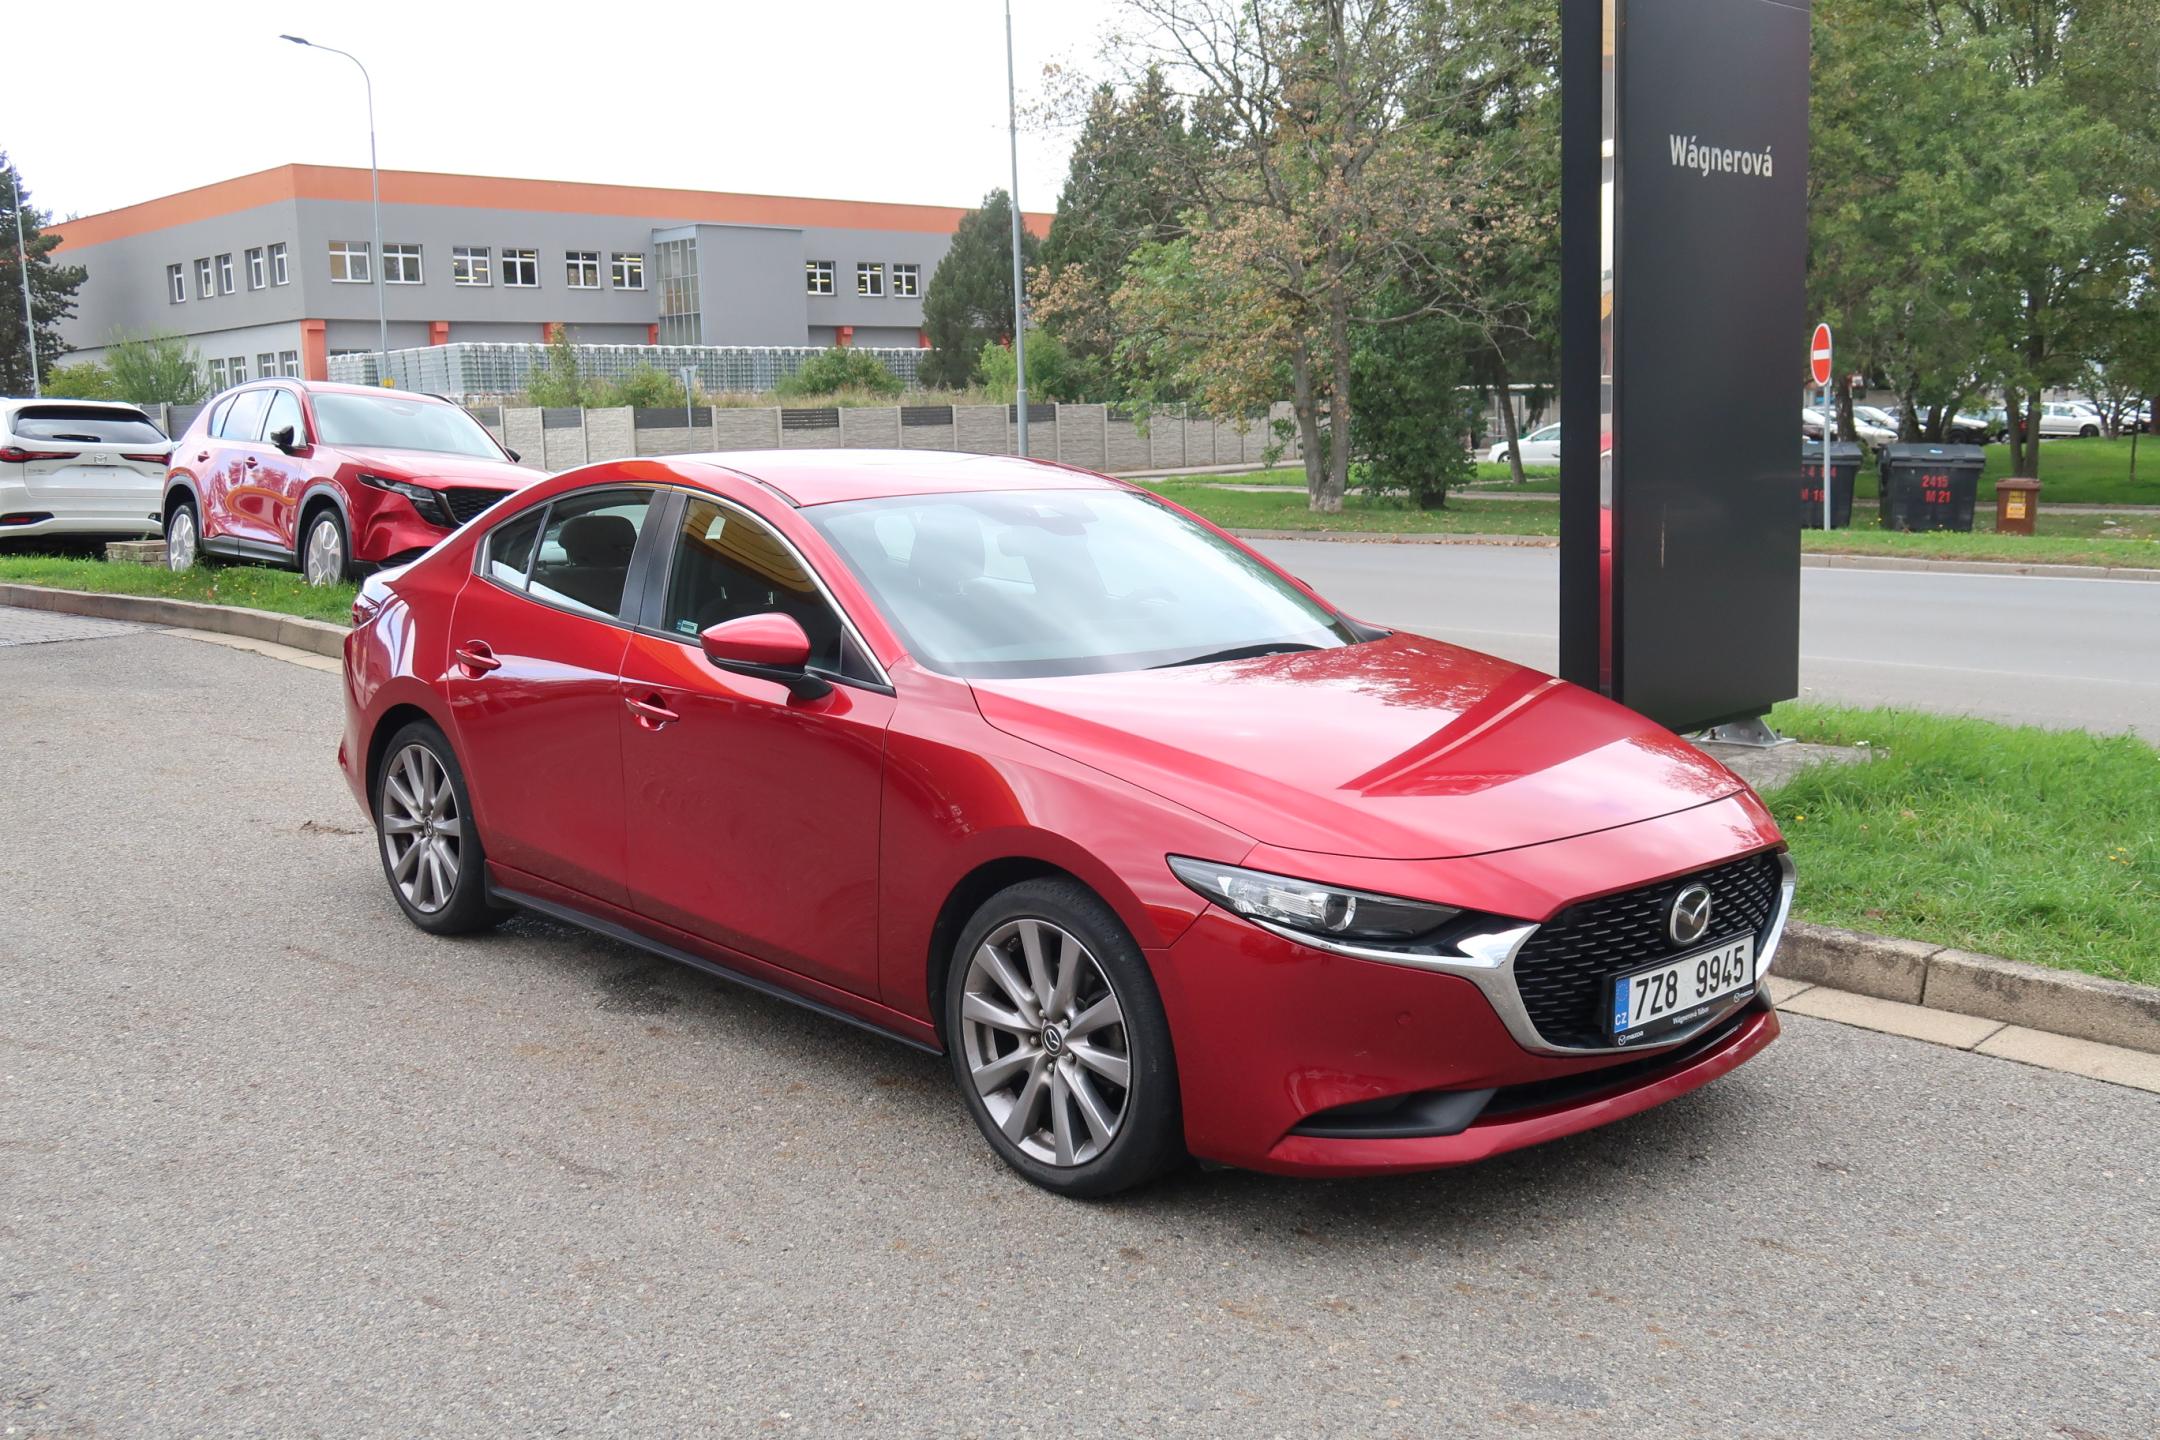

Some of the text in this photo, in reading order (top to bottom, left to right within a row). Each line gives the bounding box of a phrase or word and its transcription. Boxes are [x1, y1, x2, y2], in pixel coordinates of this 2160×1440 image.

[1669, 133, 1773, 177] Wágnerová
[1938, 489, 1951, 503] 21
[1635, 945, 1745, 1021] 7Z8 9945
[1615, 1011, 1627, 1026] CZ
